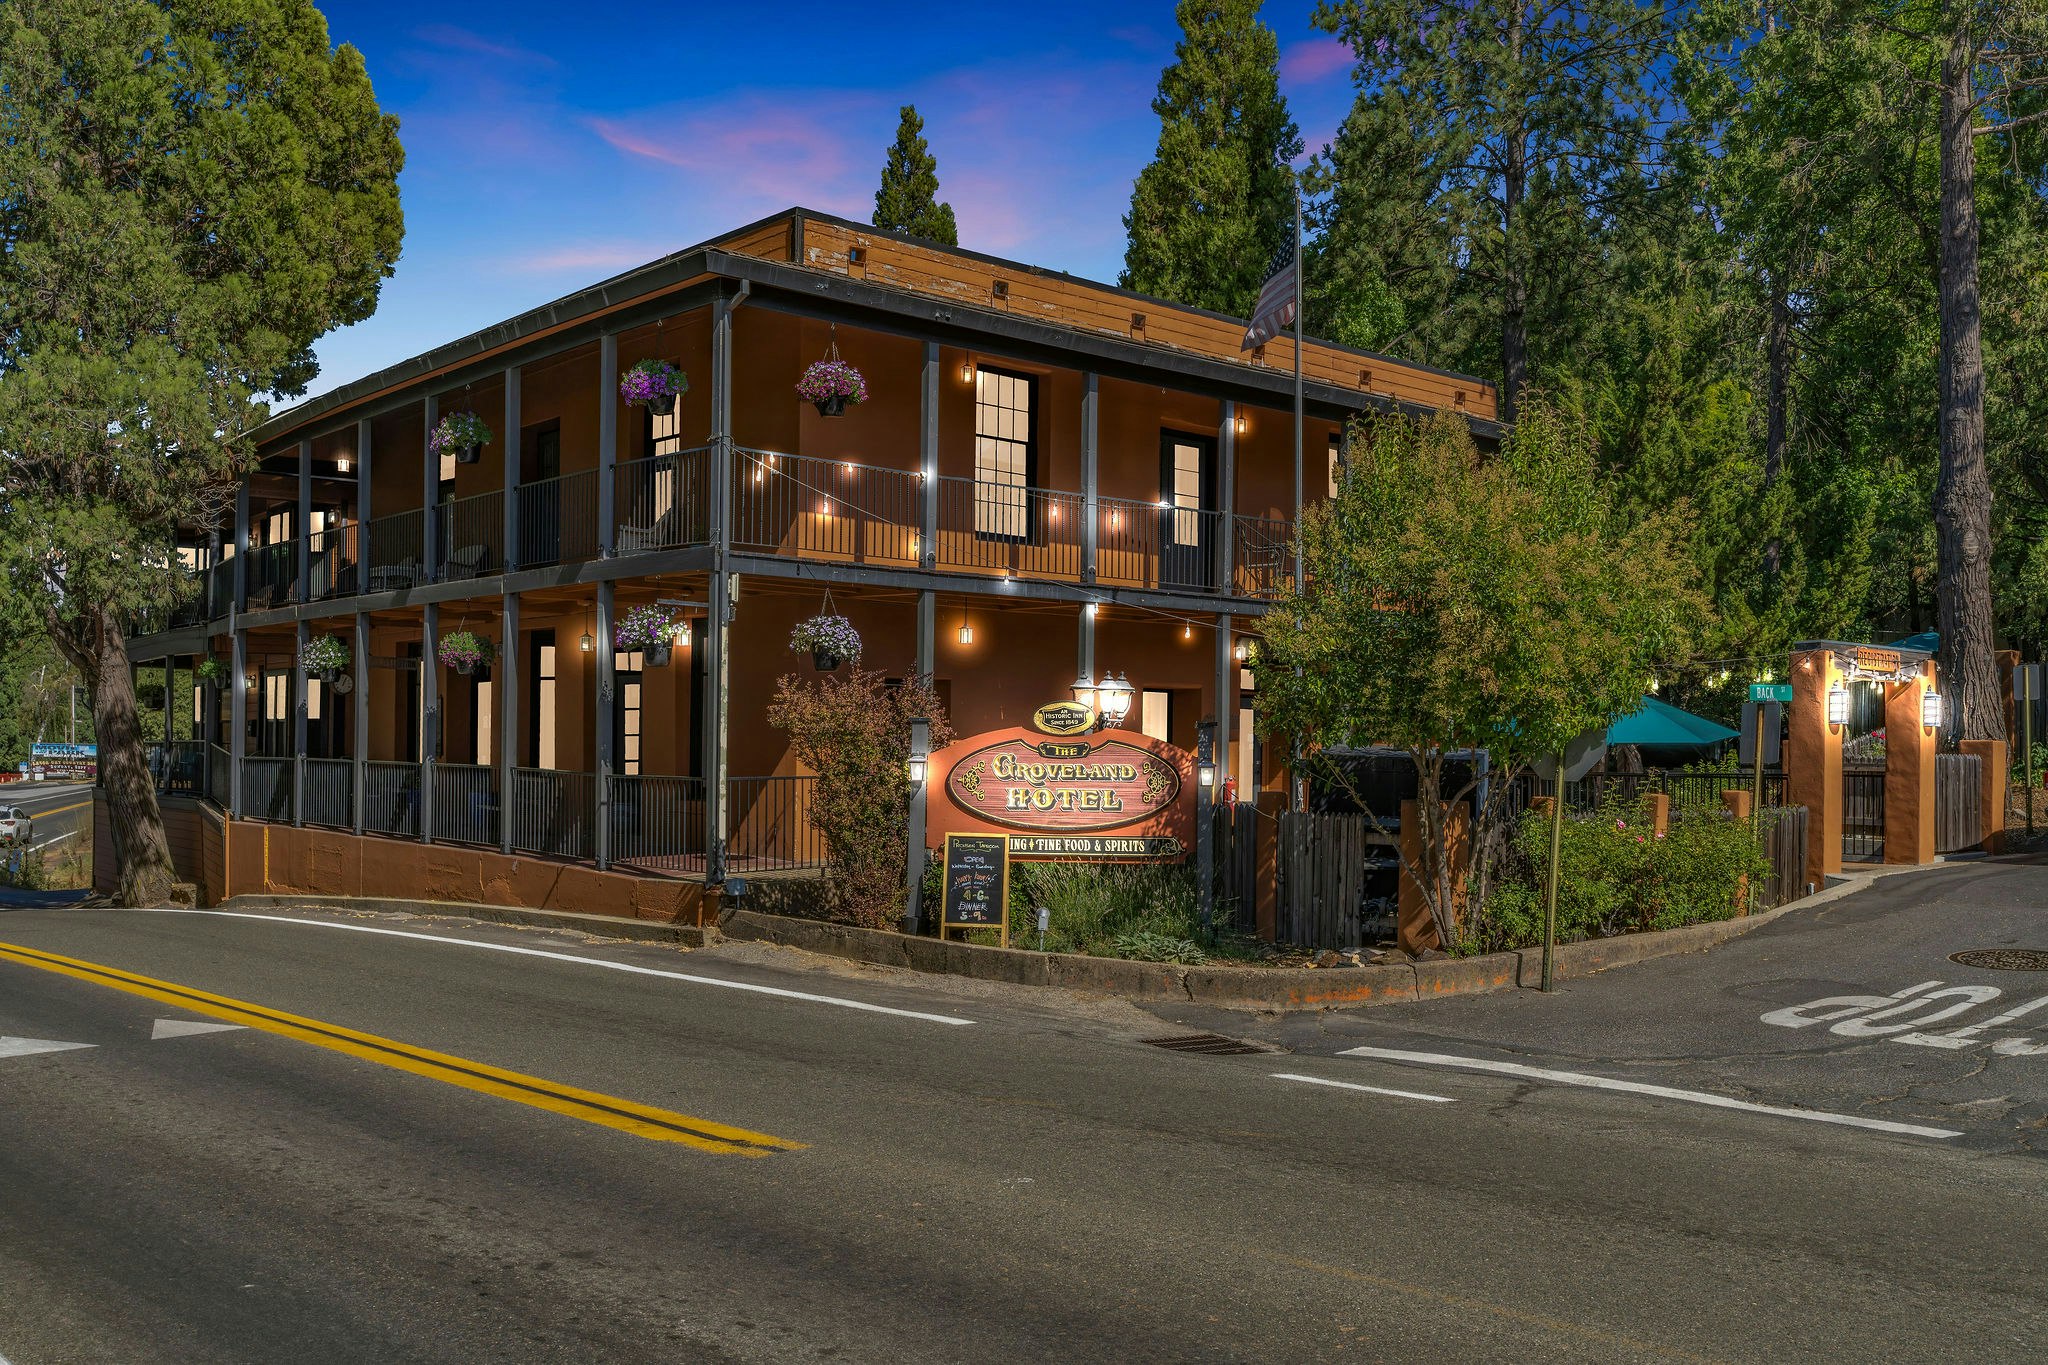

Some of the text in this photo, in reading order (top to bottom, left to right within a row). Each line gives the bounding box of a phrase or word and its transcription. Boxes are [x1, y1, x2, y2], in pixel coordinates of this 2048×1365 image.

[1757, 687, 1774, 699] BACK
[1047, 745, 1078, 756] THE
[991, 753, 1138, 787] GROVELAND
[1005, 788, 1124, 812] HOTEL
[1036, 839, 1061, 850] FINE
[1065, 839, 1091, 851] FOOD
[1094, 840, 1101, 851] &
[1105, 840, 1145, 852] SPIRITS
